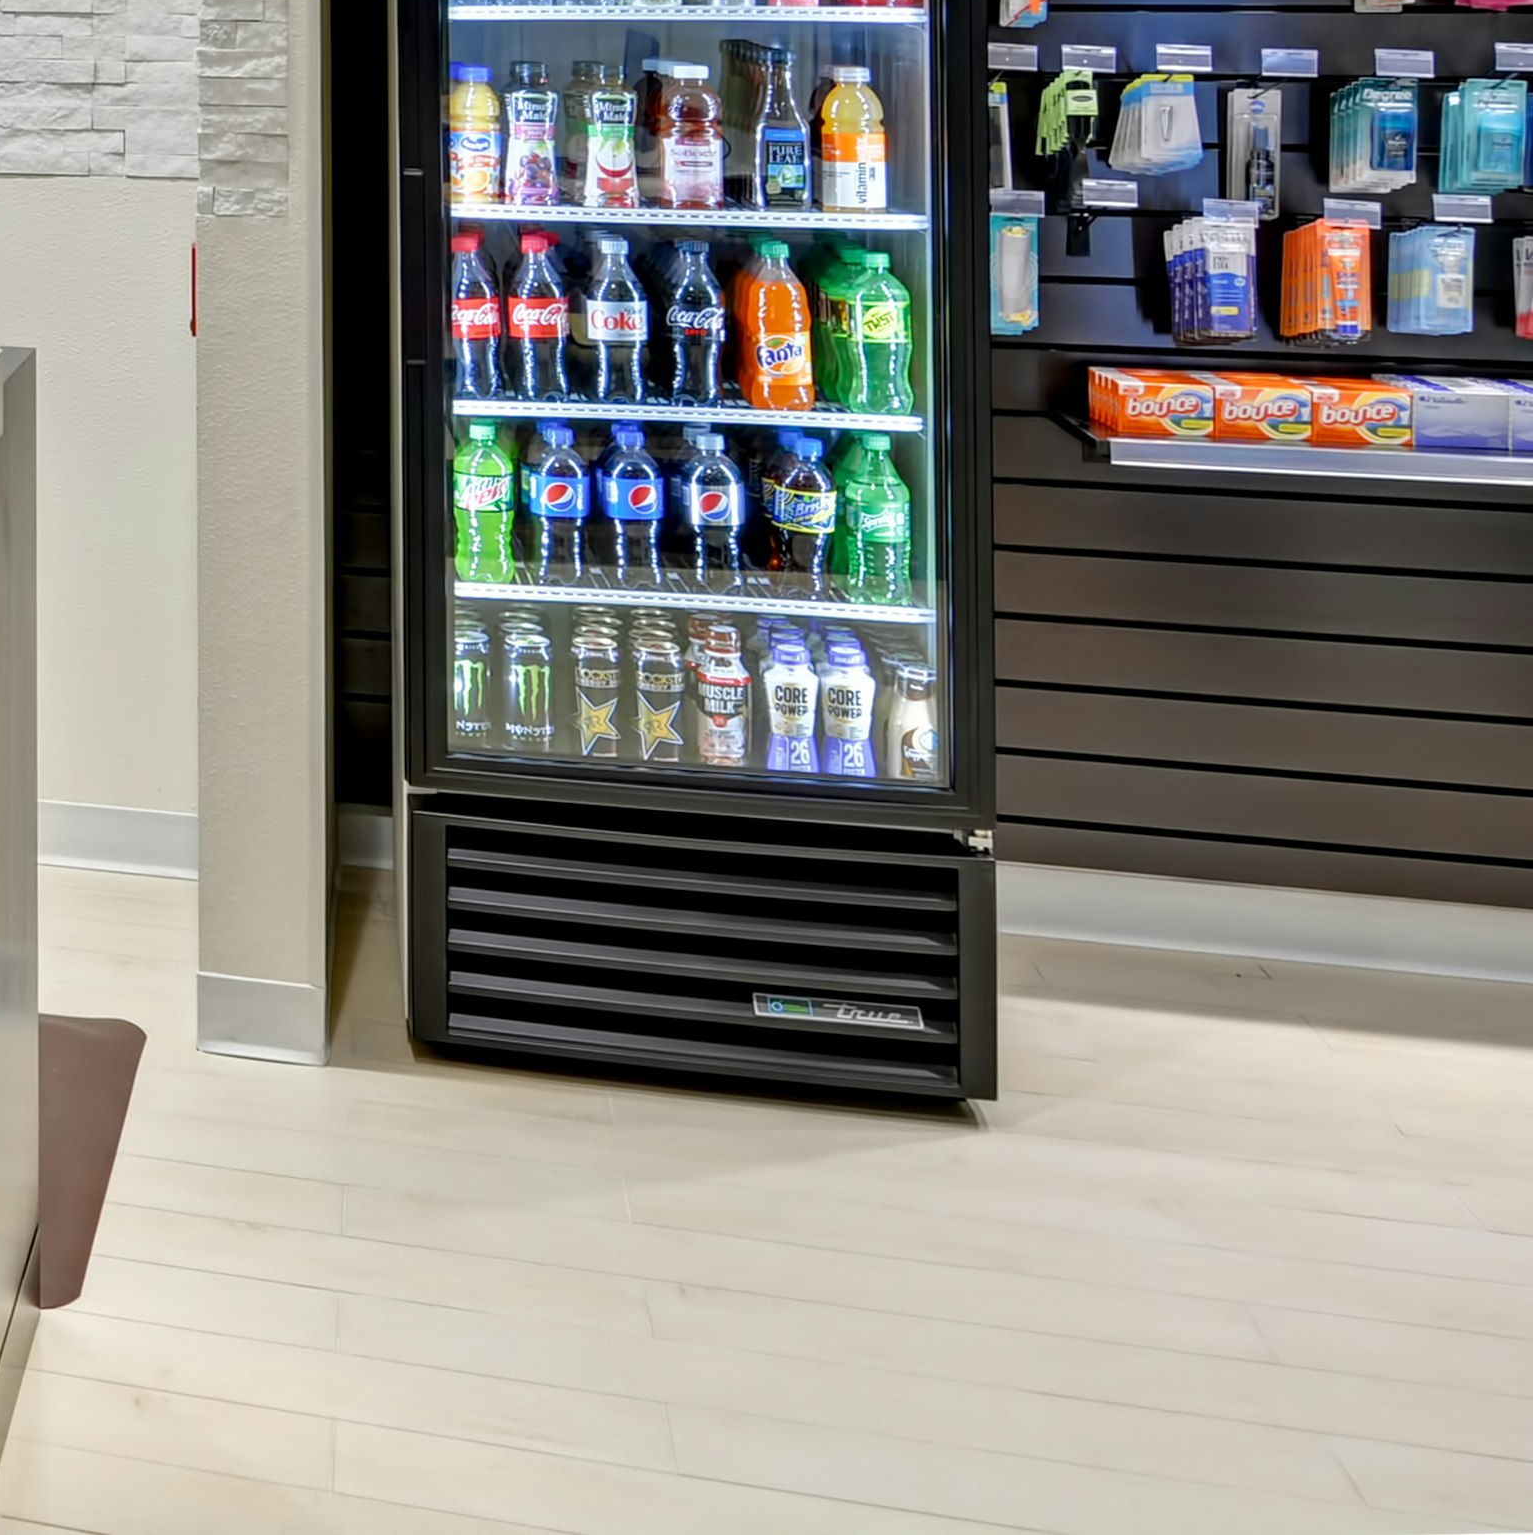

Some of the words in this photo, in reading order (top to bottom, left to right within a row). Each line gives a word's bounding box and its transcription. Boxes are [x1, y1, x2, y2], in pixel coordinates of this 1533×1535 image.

[1363, 88, 1414, 102] Degree
[768, 145, 803, 156] PURE
[855, 162, 868, 204] vitamin
[590, 308, 644, 332] Coke
[684, 327, 708, 336] zero
[1126, 396, 1199, 416] bounce
[1223, 400, 1295, 420] bounce
[1320, 404, 1394, 425] bounce
[774, 685, 809, 705] CORE
[827, 686, 863, 707] CORE
[704, 698, 736, 714] MILK
[774, 703, 809, 717] POWER
[827, 706, 863, 720] POWER
[790, 740, 811, 765] 26
[843, 743, 865, 768] 26
